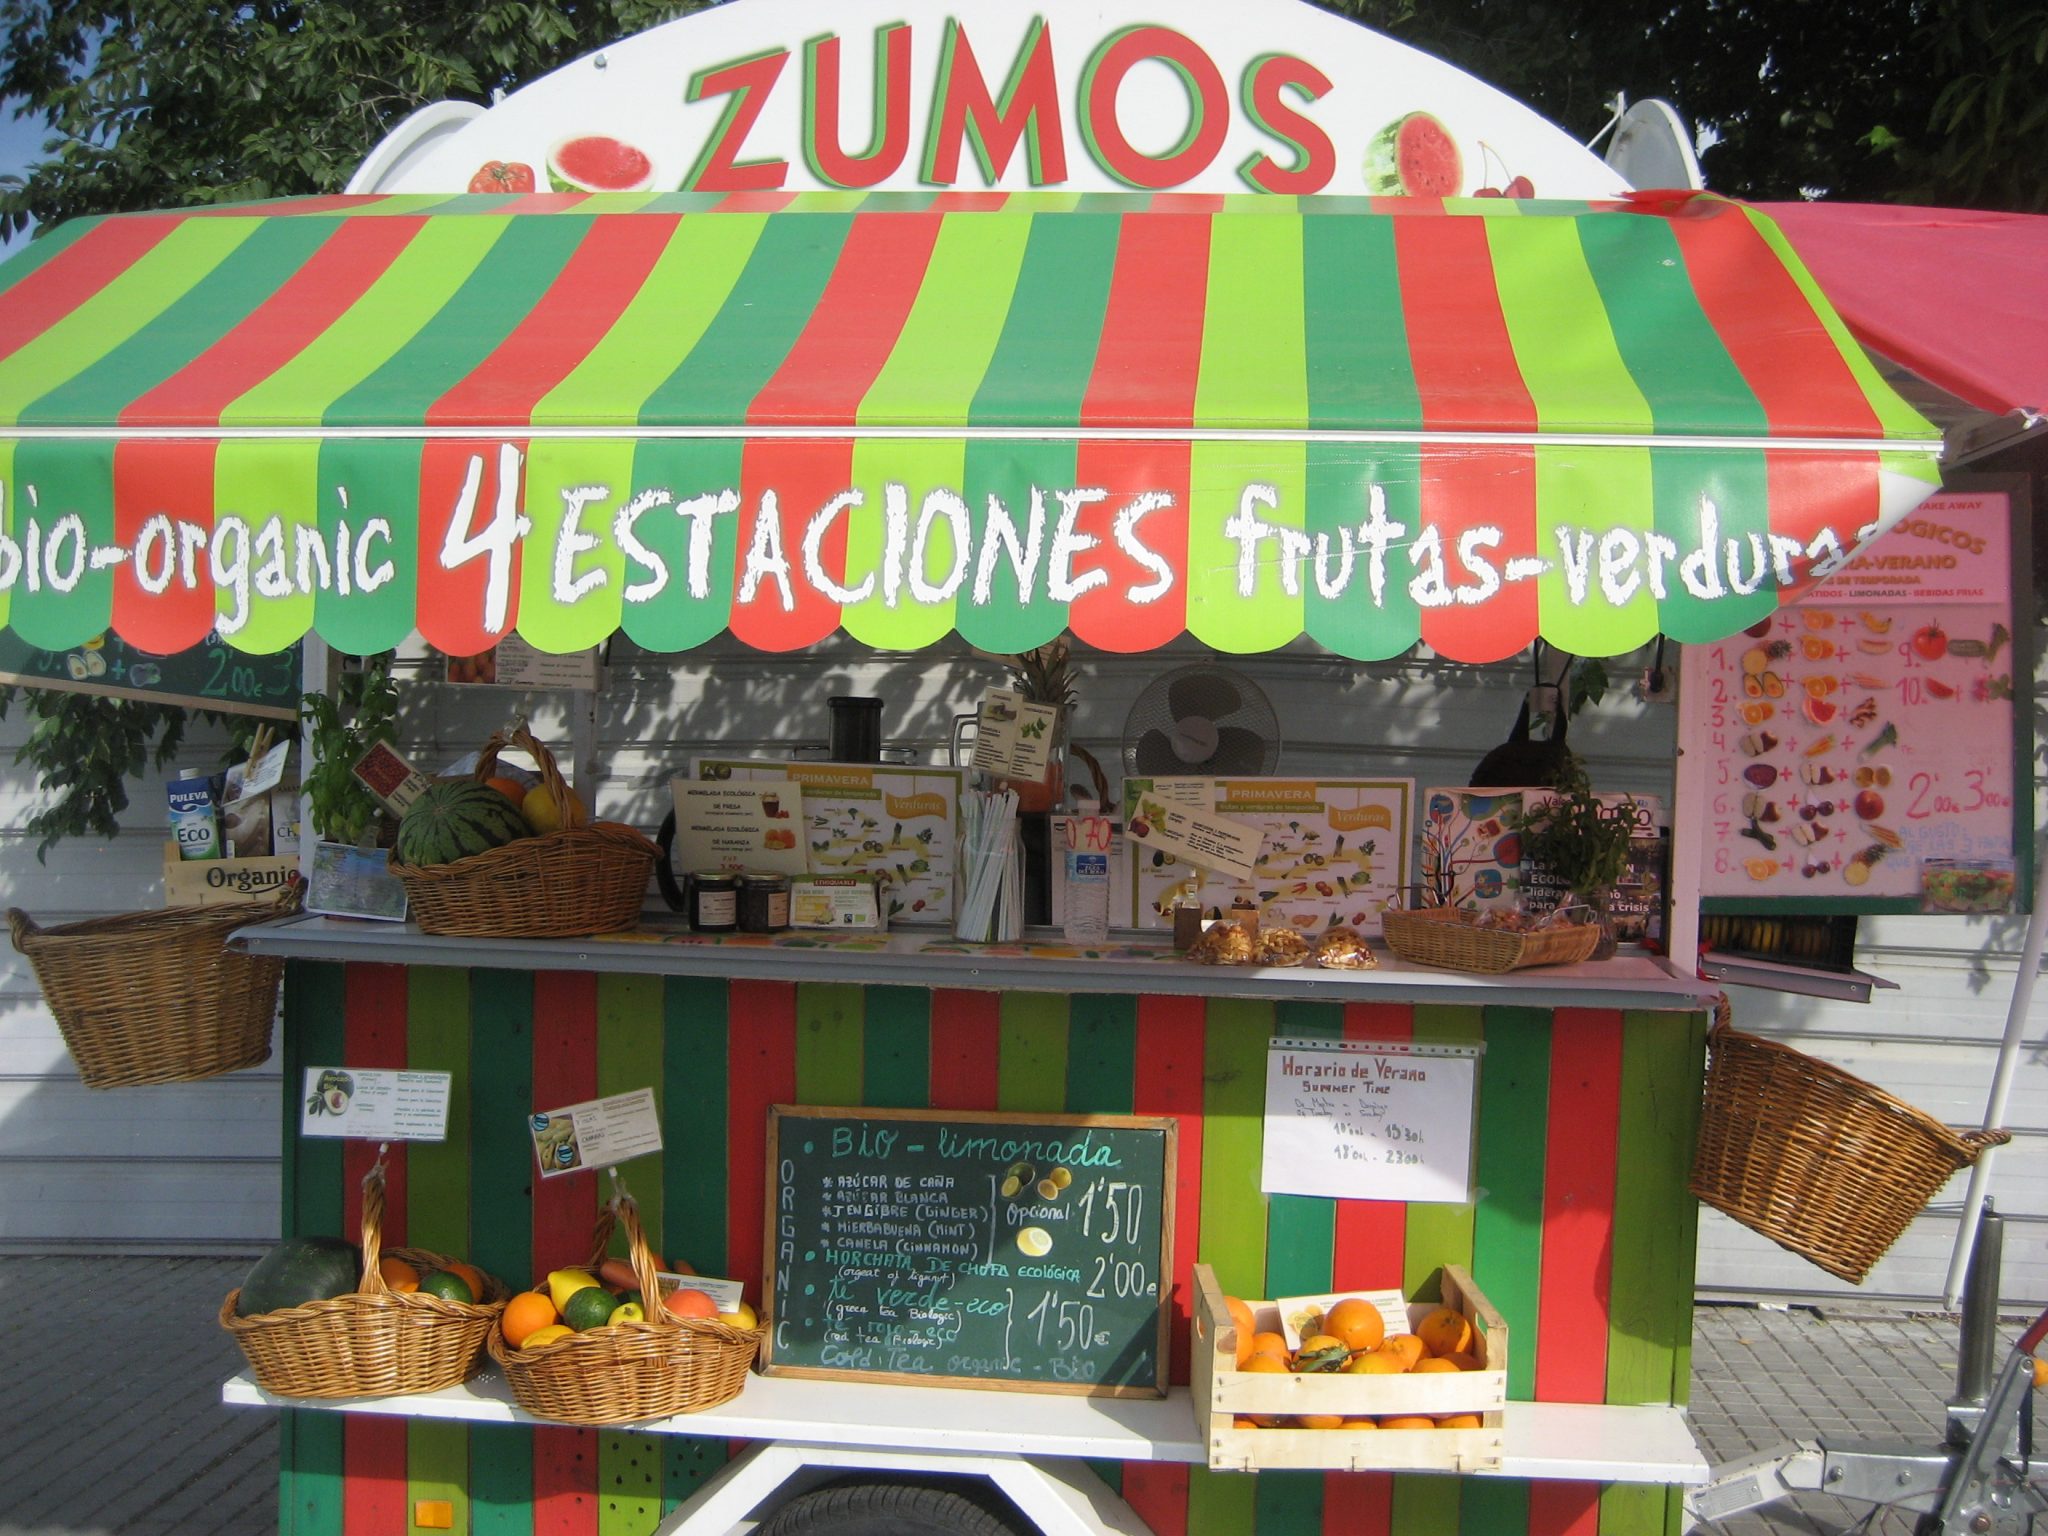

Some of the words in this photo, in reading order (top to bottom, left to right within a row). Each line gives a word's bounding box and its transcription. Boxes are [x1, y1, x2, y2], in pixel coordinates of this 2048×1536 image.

[679, 14, 1337, 194] ZUMOS
[1948, 502, 1982, 510] AWAY
[441, 443, 531, 633] 4
[553, 483, 1175, 611] ESTACIONES
[1849, 589, 1907, 598] LIMONADAS
[1913, 587, 1953, 597] BEBIDAS
[792, 773, 869, 786] PRIMAVERA
[169, 791, 208, 804] PULEVA
[1231, 789, 1312, 800] PRIMAVERA
[893, 798, 941, 810] Verduras
[1335, 811, 1386, 823] Verduras
[1618, 900, 1650, 912] crisis
[1282, 1055, 1346, 1078] Horario
[1351, 1061, 1369, 1079] de
[1374, 1057, 1427, 1082] Verano
[1303, 1081, 1356, 1094] Summer
[1363, 1081, 1391, 1094] Time
[938, 1126, 1121, 1168] limonada
[895, 1176, 911, 1188] DE
[920, 1174, 955, 1188] CAÑA
[836, 1238, 888, 1251] CANELA
[825, 1248, 913, 1270] HORCHATA
[925, 1256, 952, 1274] DE
